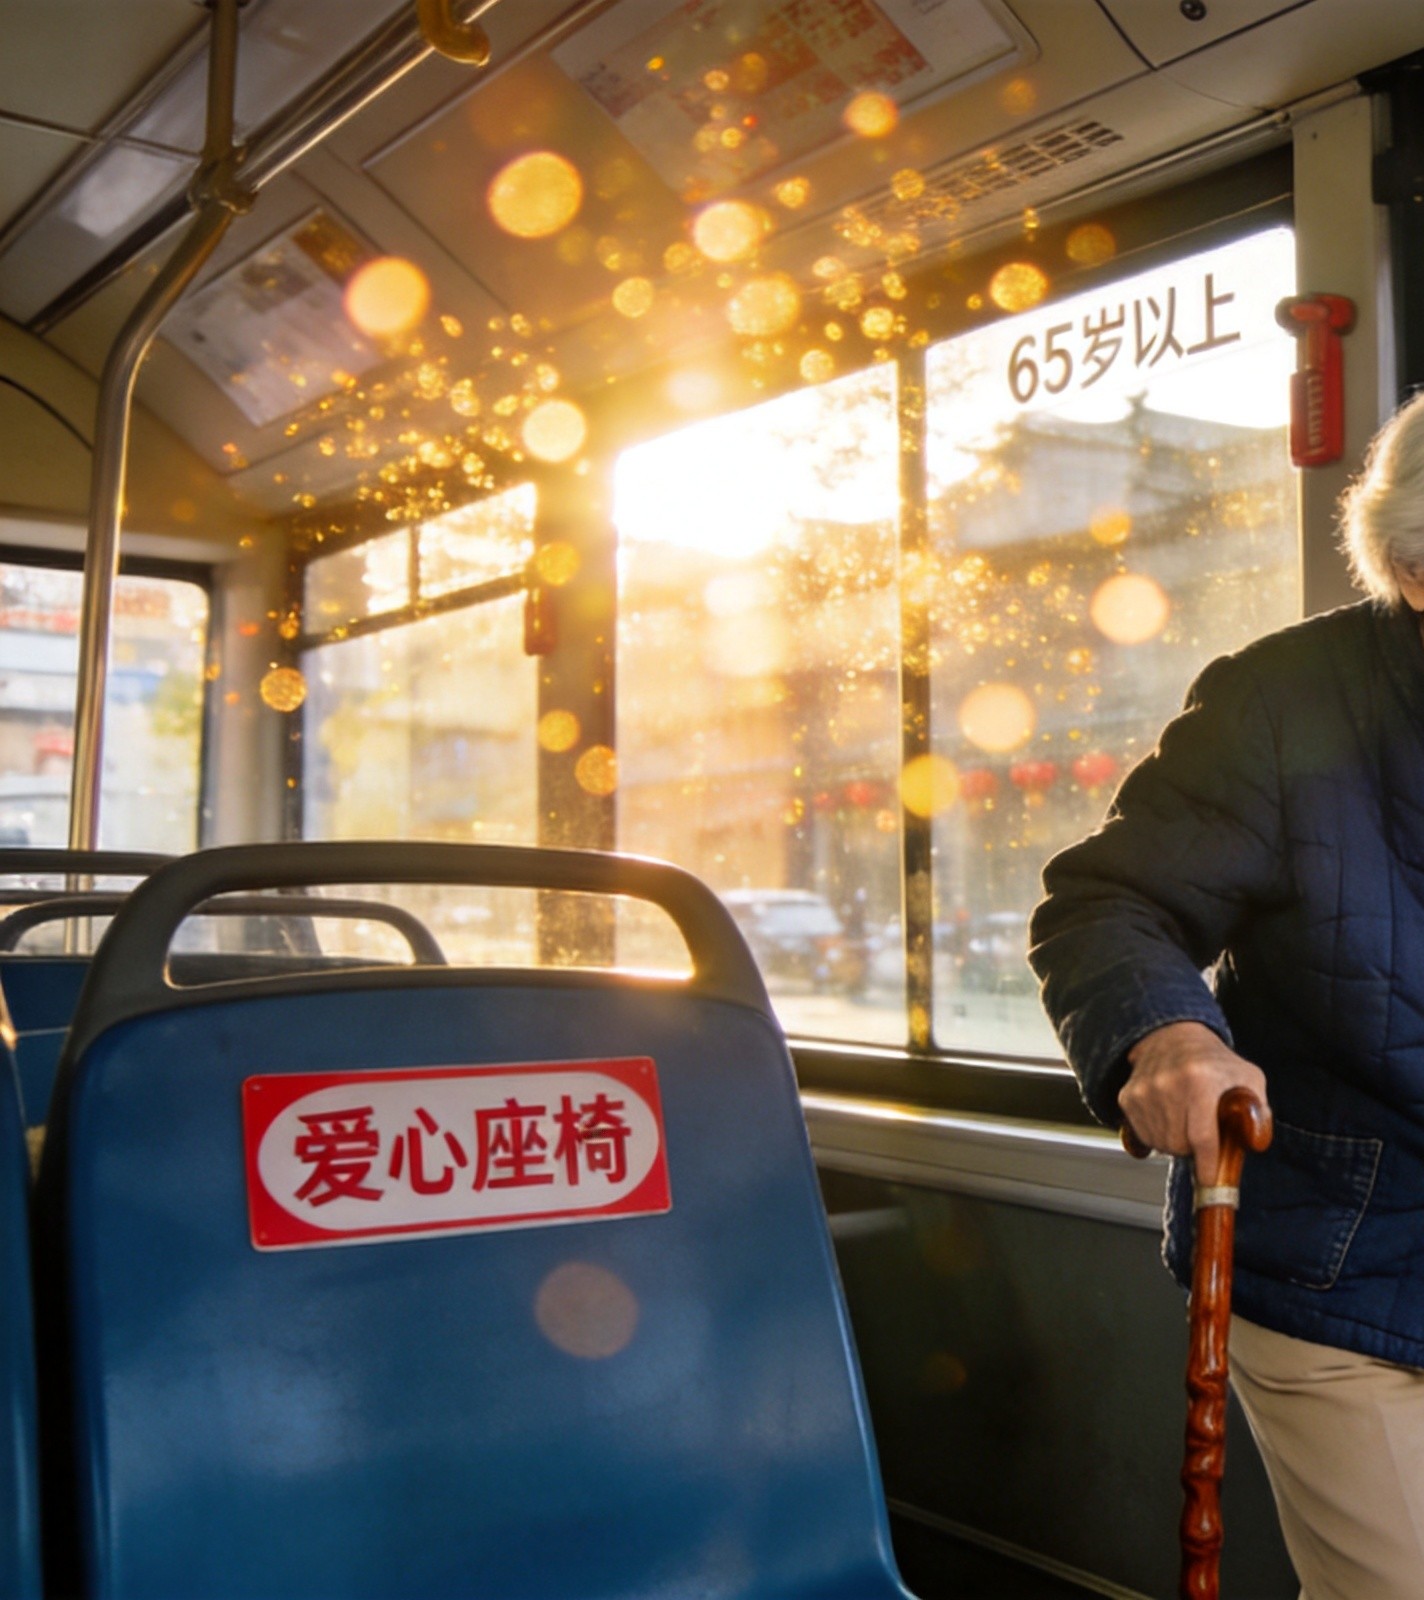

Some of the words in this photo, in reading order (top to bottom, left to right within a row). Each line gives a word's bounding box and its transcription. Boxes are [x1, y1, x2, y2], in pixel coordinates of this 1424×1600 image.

[1008, 273, 1241, 404] 65岁以上
[294, 1093, 632, 1208] 爱心座椅
